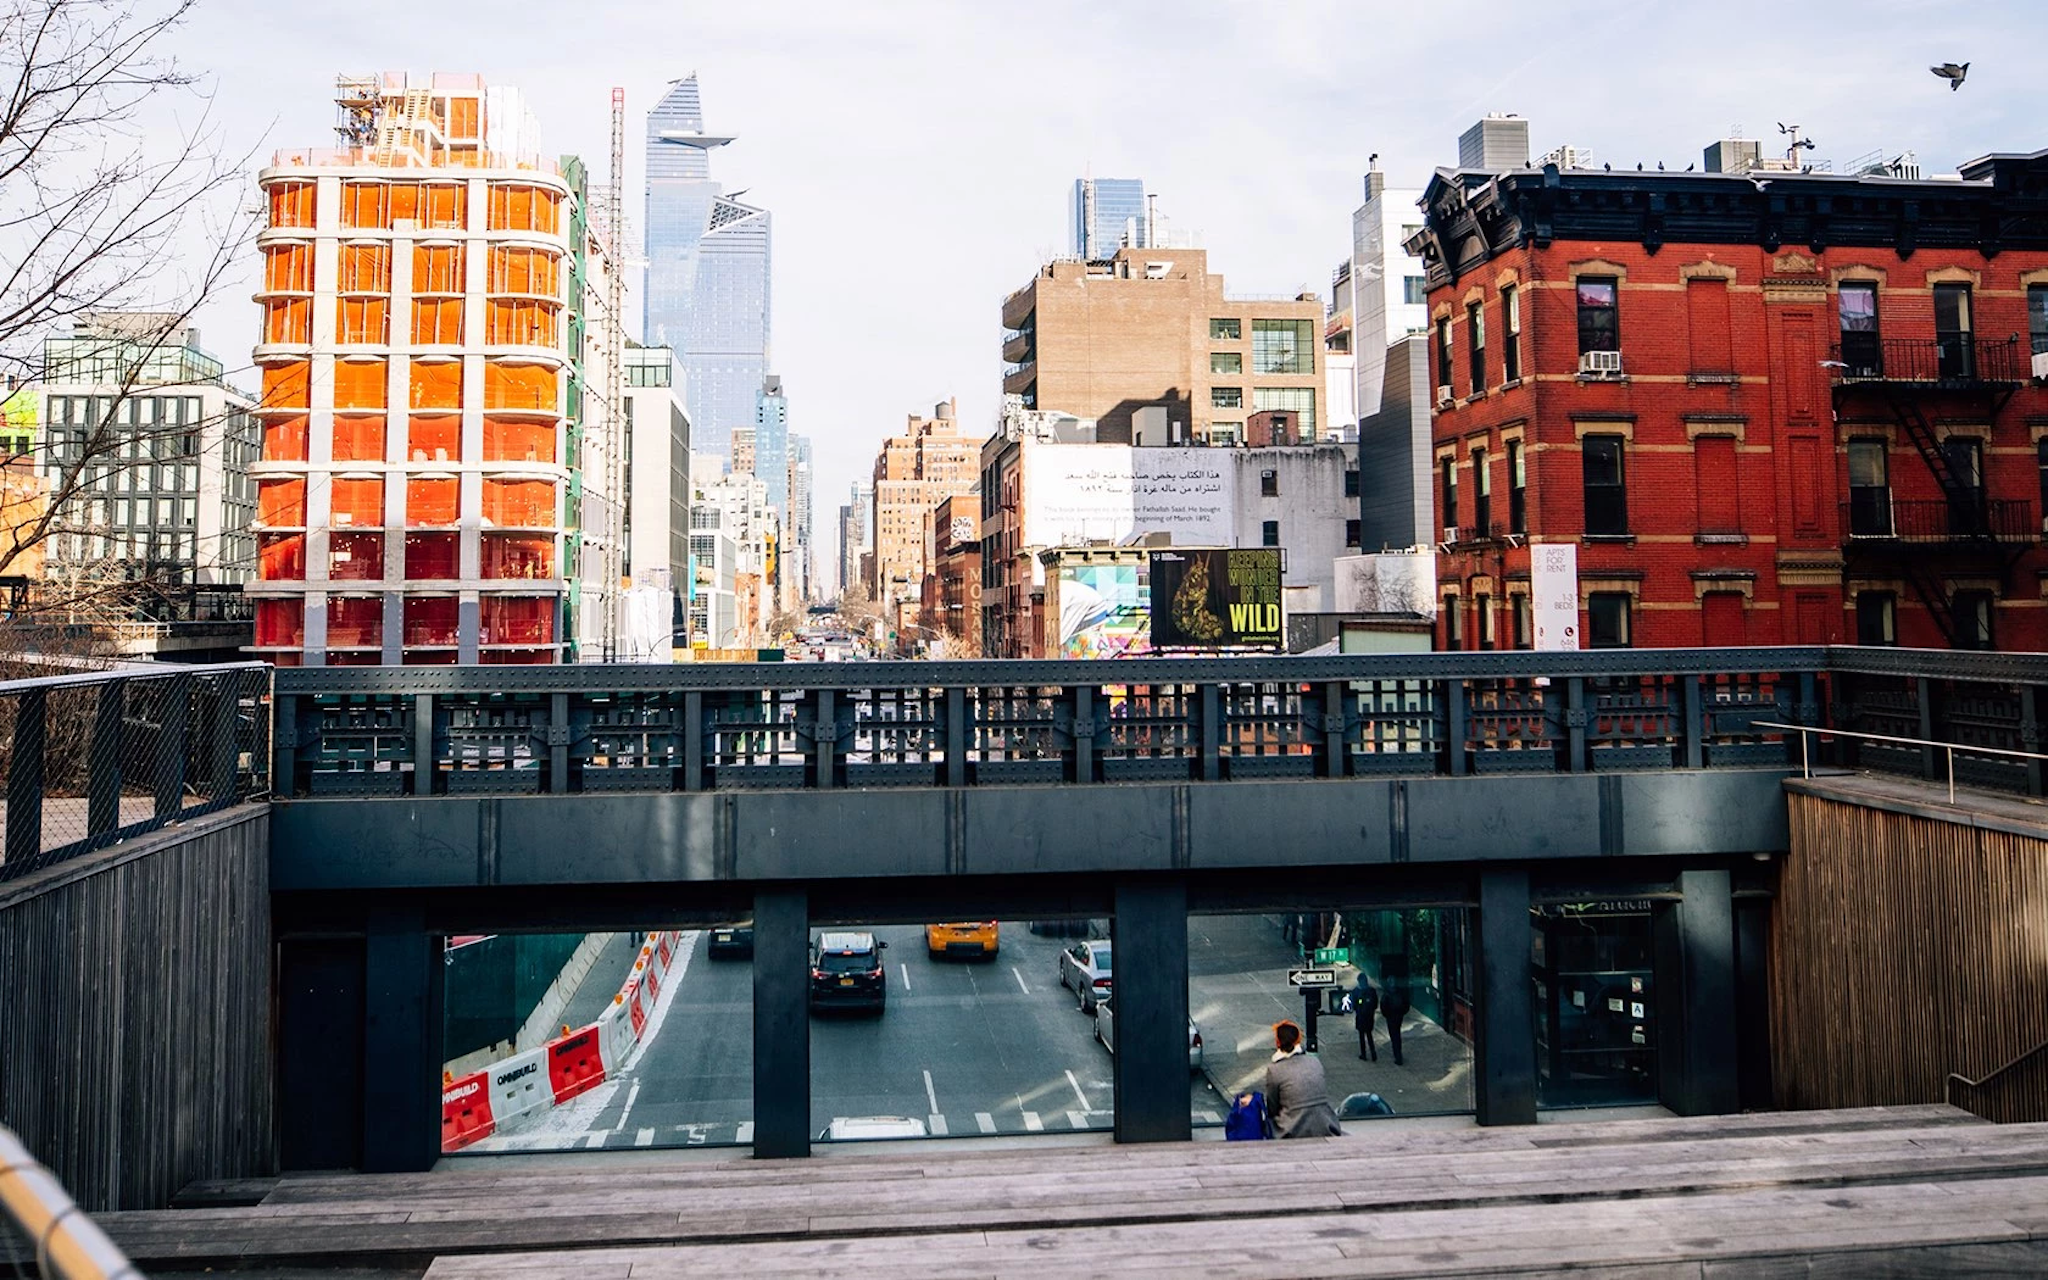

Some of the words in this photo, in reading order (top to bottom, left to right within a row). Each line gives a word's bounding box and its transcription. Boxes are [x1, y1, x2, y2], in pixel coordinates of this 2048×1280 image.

[1179, 470, 1204, 482] الكتاب
[1206, 469, 1220, 479] هذا
[1179, 485, 1192, 495] من
[1199, 506, 1221, 514] bought
[1135, 515, 1164, 523] beginning
[1546, 548, 1566, 556] APTS
[1546, 565, 1566, 573] RENT
[1240, 586, 1254, 603] IN
[1257, 586, 1279, 603] THE
[1554, 601, 1574, 610] BEDS
[1229, 603, 1280, 632] WILD
[1320, 951, 1327, 960] W
[1328, 951, 1336, 960] 17
[1634, 1005, 1641, 1014] A
[497, 1062, 537, 1086] OMNIBUILD
[442, 1082, 479, 1105] MNIBUILD
